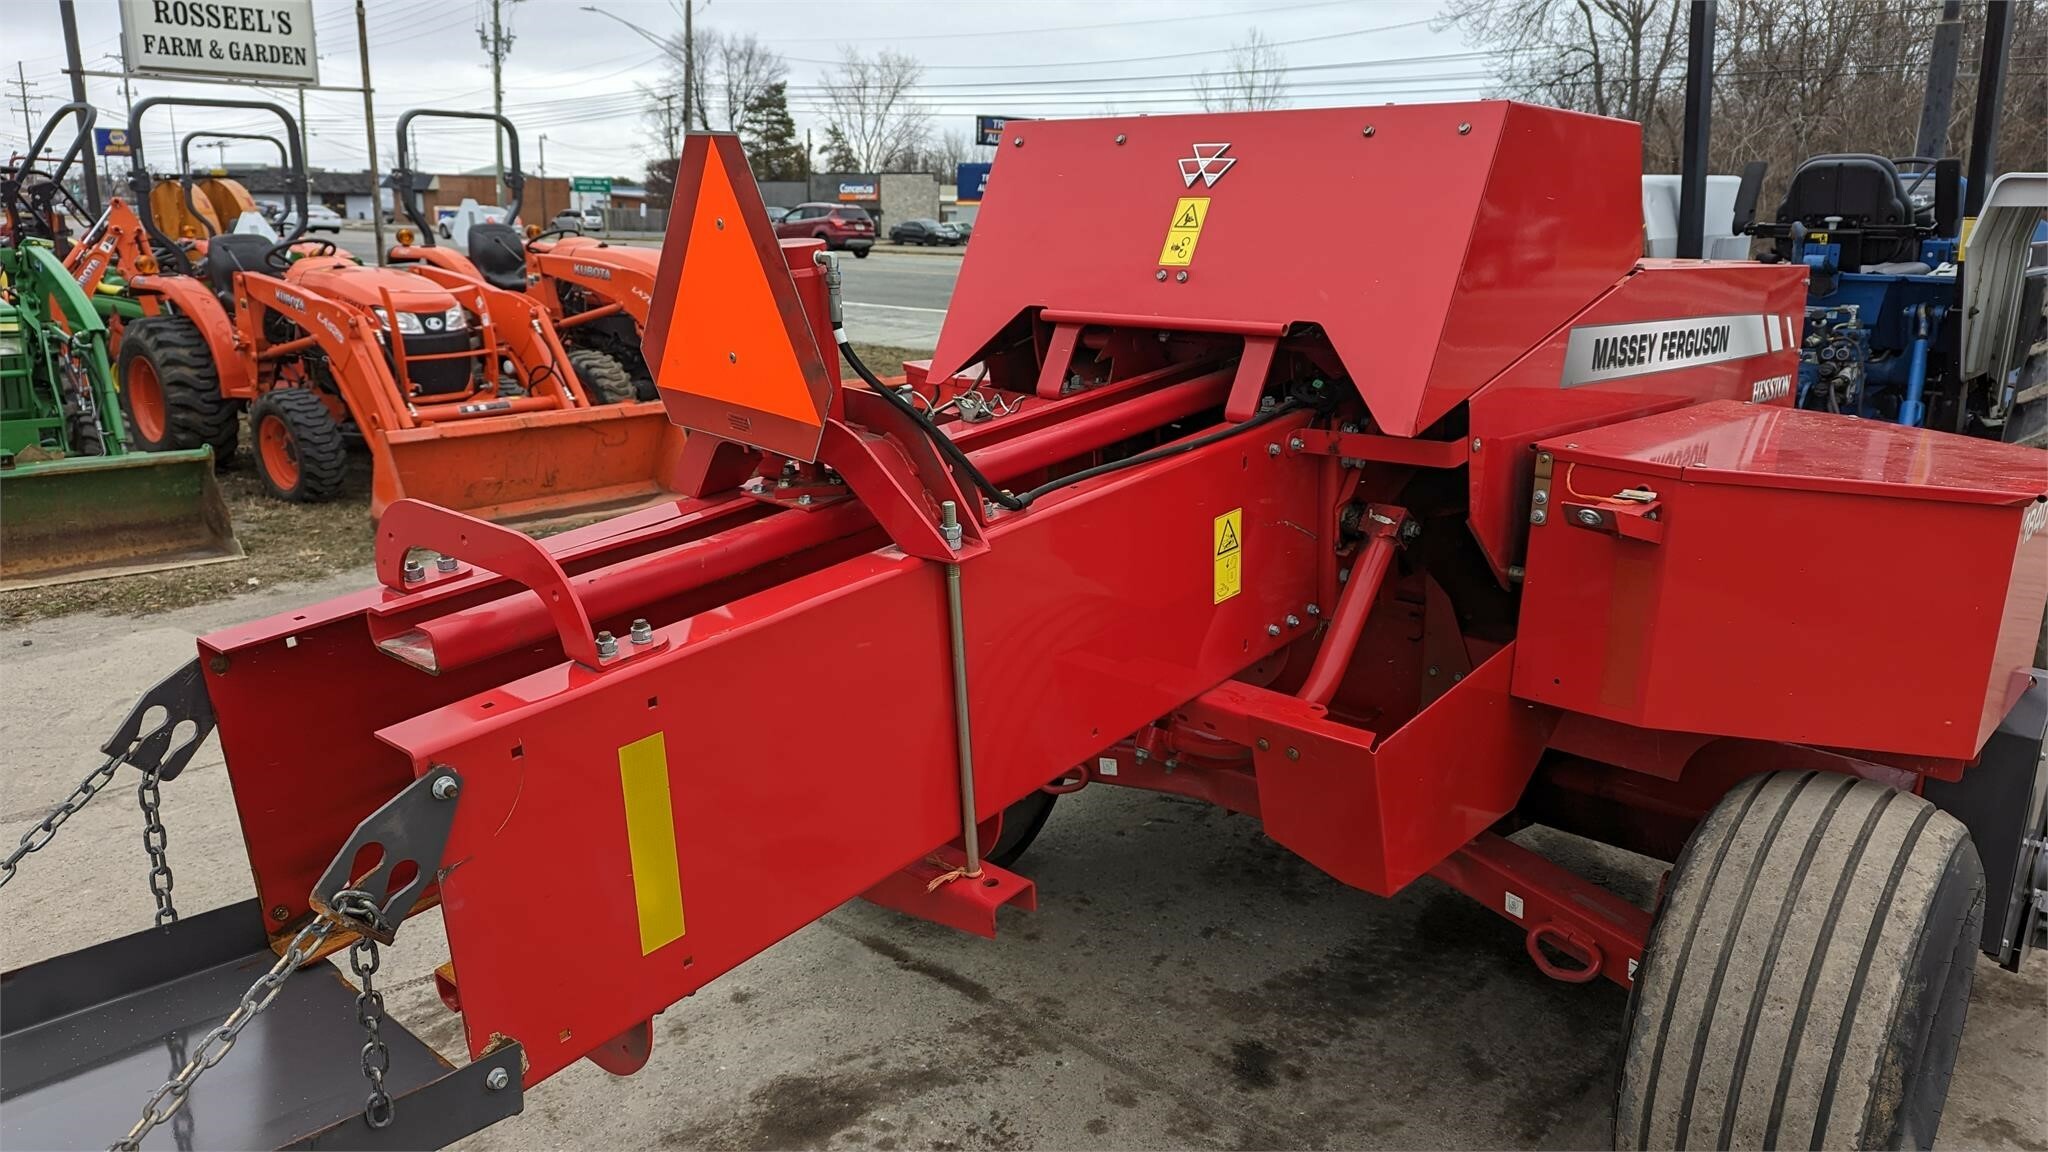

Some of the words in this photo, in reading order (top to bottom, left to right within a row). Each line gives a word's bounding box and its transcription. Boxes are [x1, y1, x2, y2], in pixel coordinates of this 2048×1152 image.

[154, 0, 292, 35] ROSSEEL'S
[143, 34, 204, 58] FARM
[209, 40, 224, 60] &
[229, 41, 307, 66] GARDEN
[573, 263, 612, 279] KUBOTA
[275, 287, 306, 312] KUBOTA
[1591, 332, 1659, 372] MASSEY
[1659, 325, 1731, 362] FERGUSON
[1752, 374, 1792, 403] HESSTON
